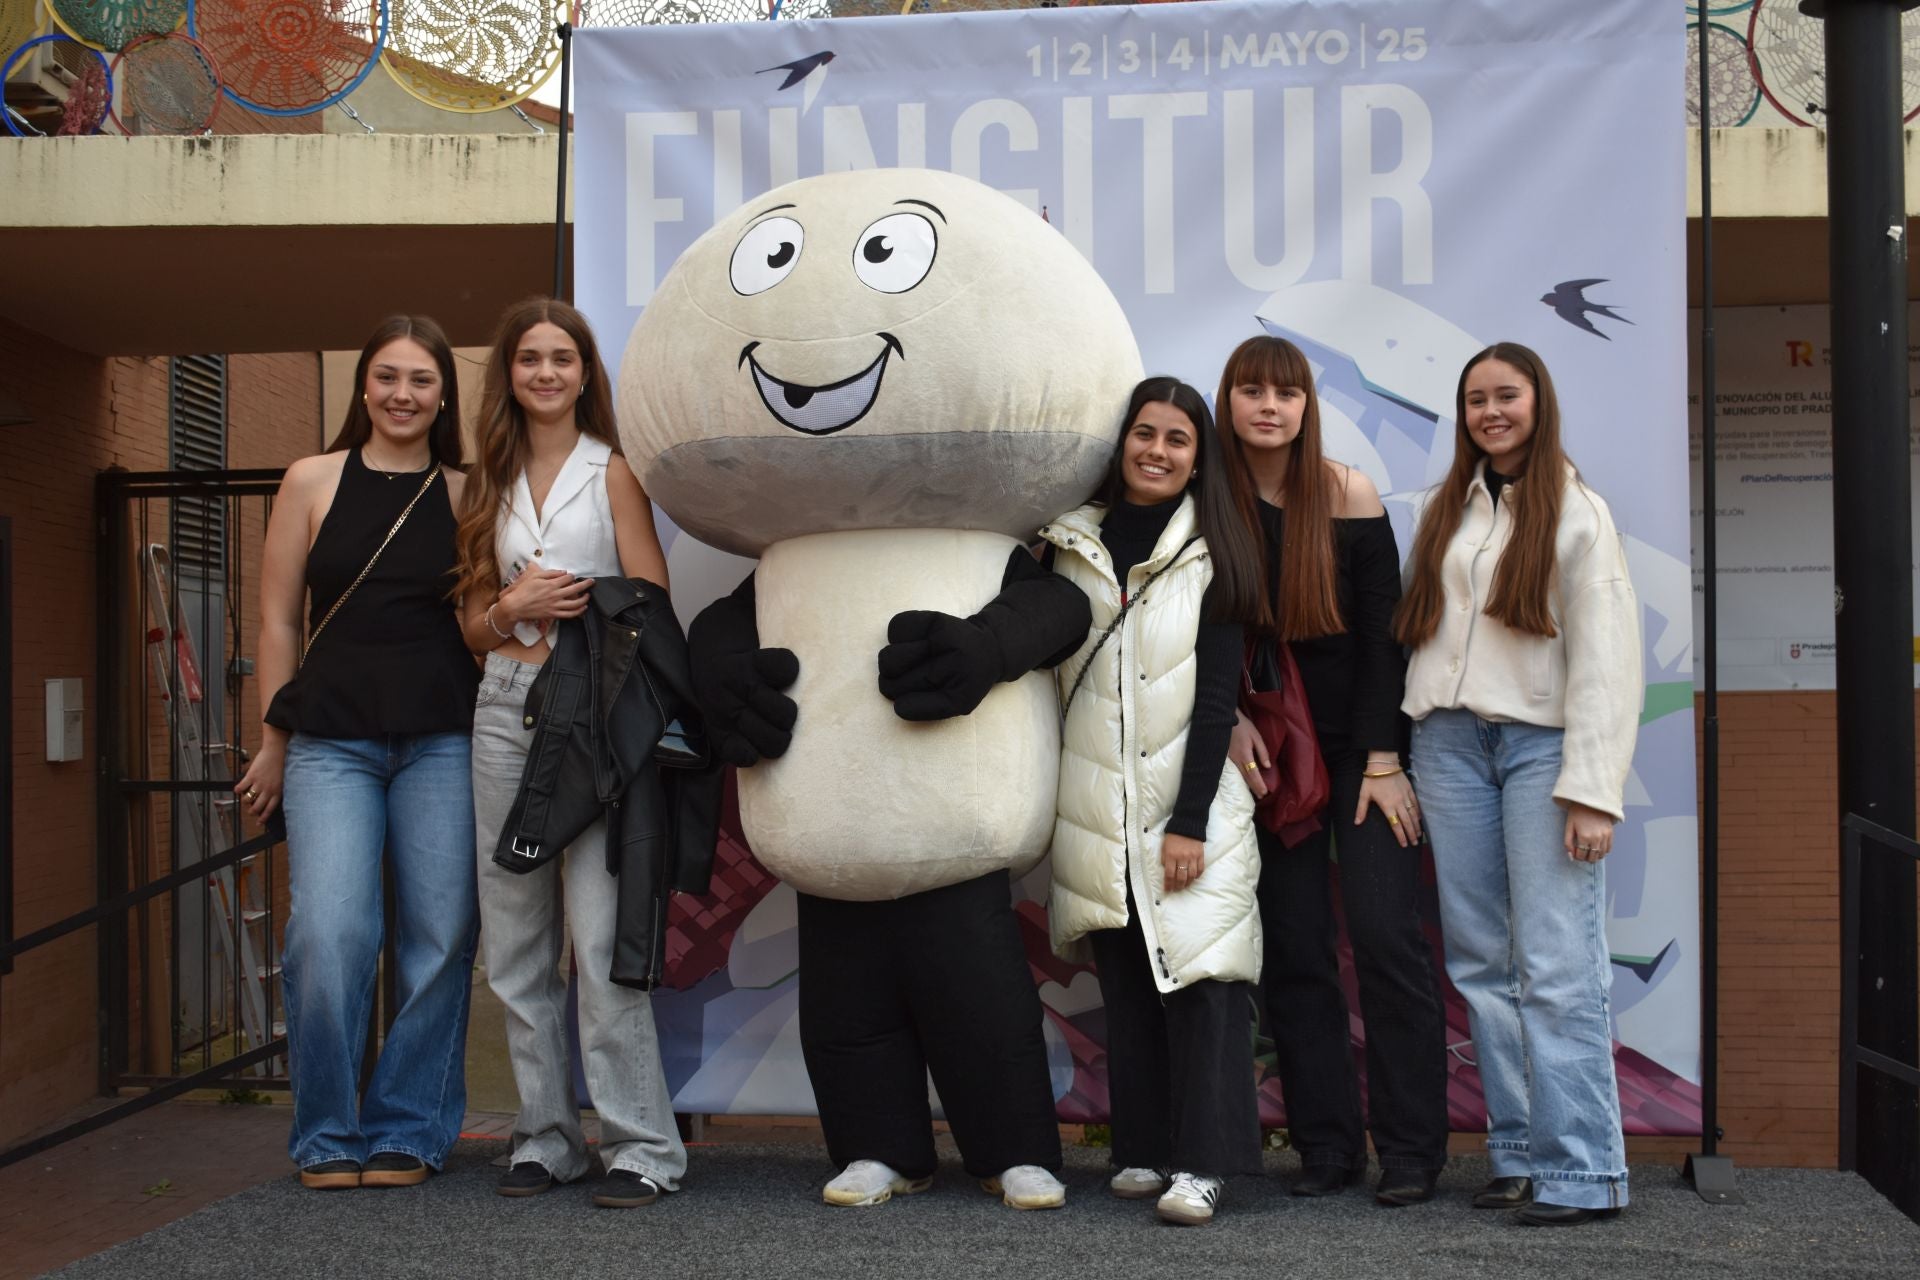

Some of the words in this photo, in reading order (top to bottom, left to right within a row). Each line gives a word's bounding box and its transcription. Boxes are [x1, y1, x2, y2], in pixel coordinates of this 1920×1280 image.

[1220, 29, 1350, 69] MAYO
[1376, 27, 1428, 62] 25
[1714, 391, 1782, 404] ENOVACIÓN
[1785, 392, 1806, 401] DEL
[1723, 404, 1780, 416] MUNICIPIO
[1783, 405, 1798, 415] DE
